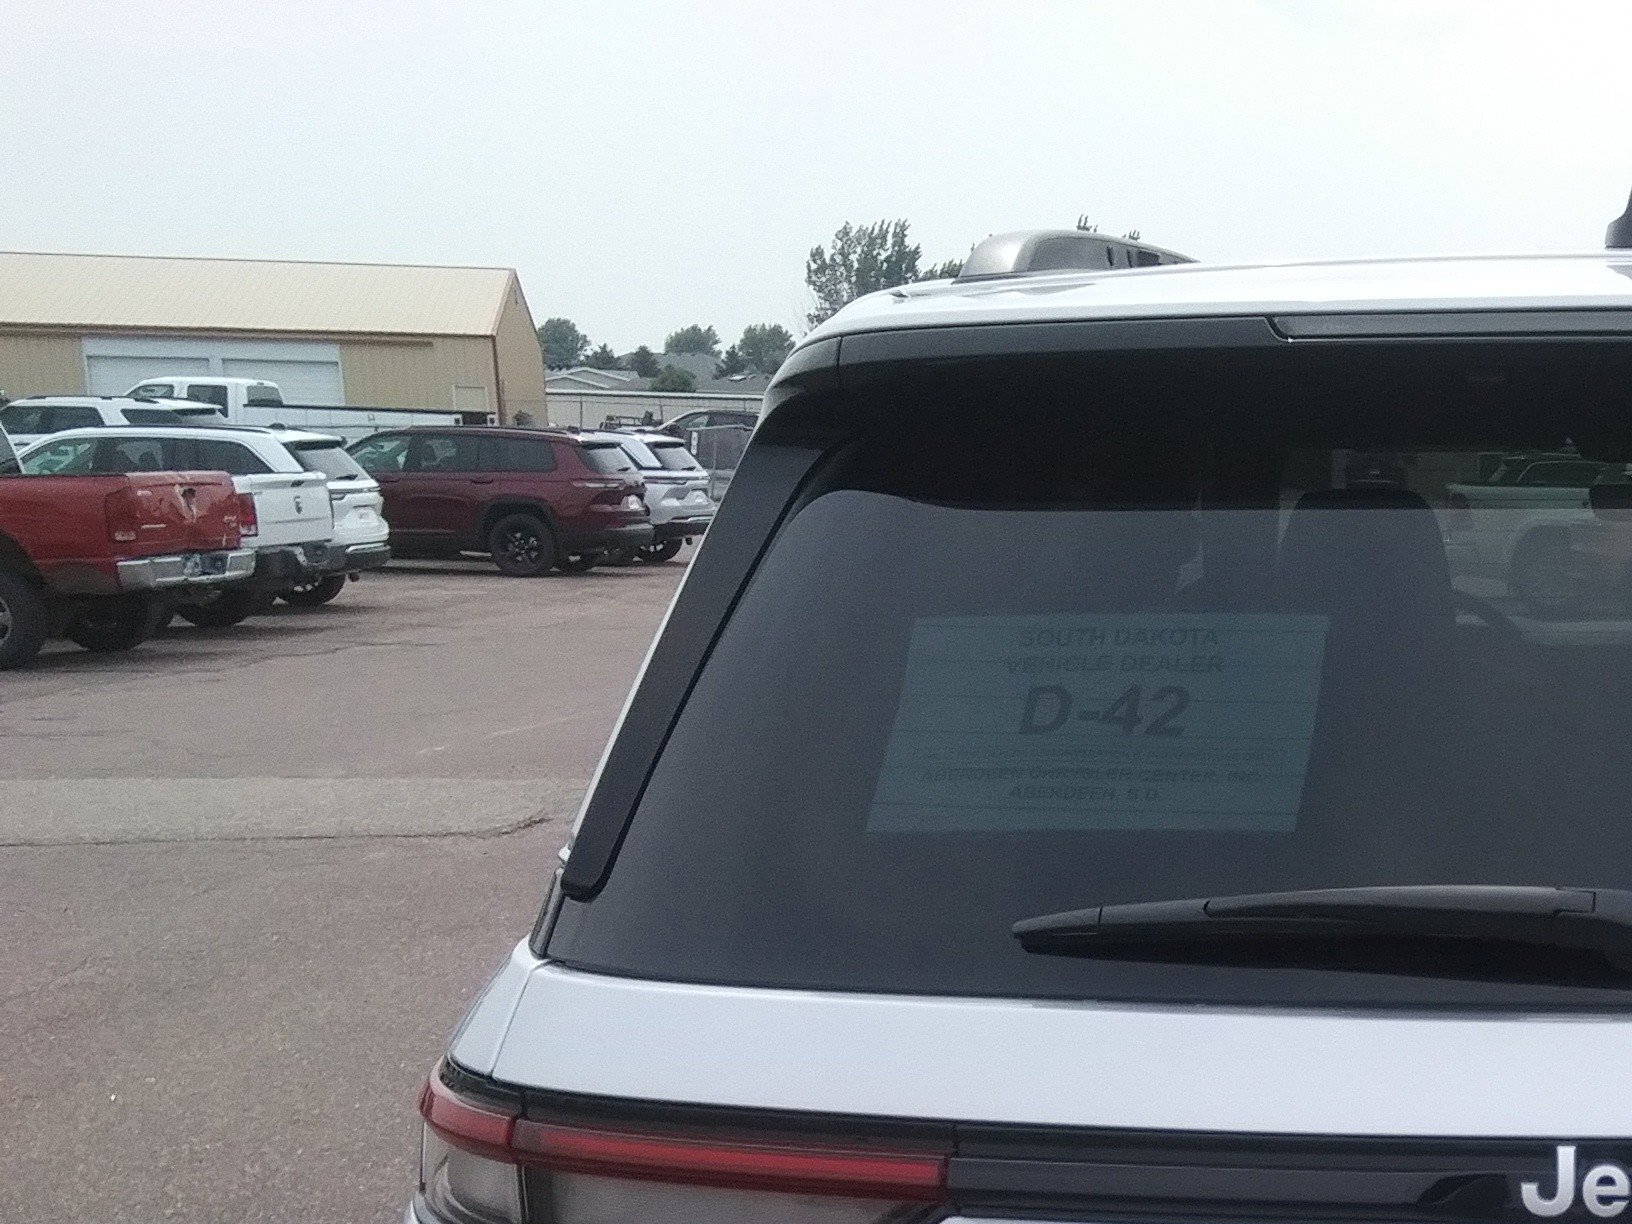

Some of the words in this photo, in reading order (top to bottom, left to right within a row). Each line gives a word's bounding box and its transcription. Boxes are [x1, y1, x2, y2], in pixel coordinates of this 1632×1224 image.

[1018, 627, 1106, 647] SOUTH
[1114, 627, 1219, 646] DAKOTA
[1006, 655, 1113, 675] VEHICLE
[1119, 654, 1224, 674] DEALER
[1018, 683, 1191, 737] D-42
